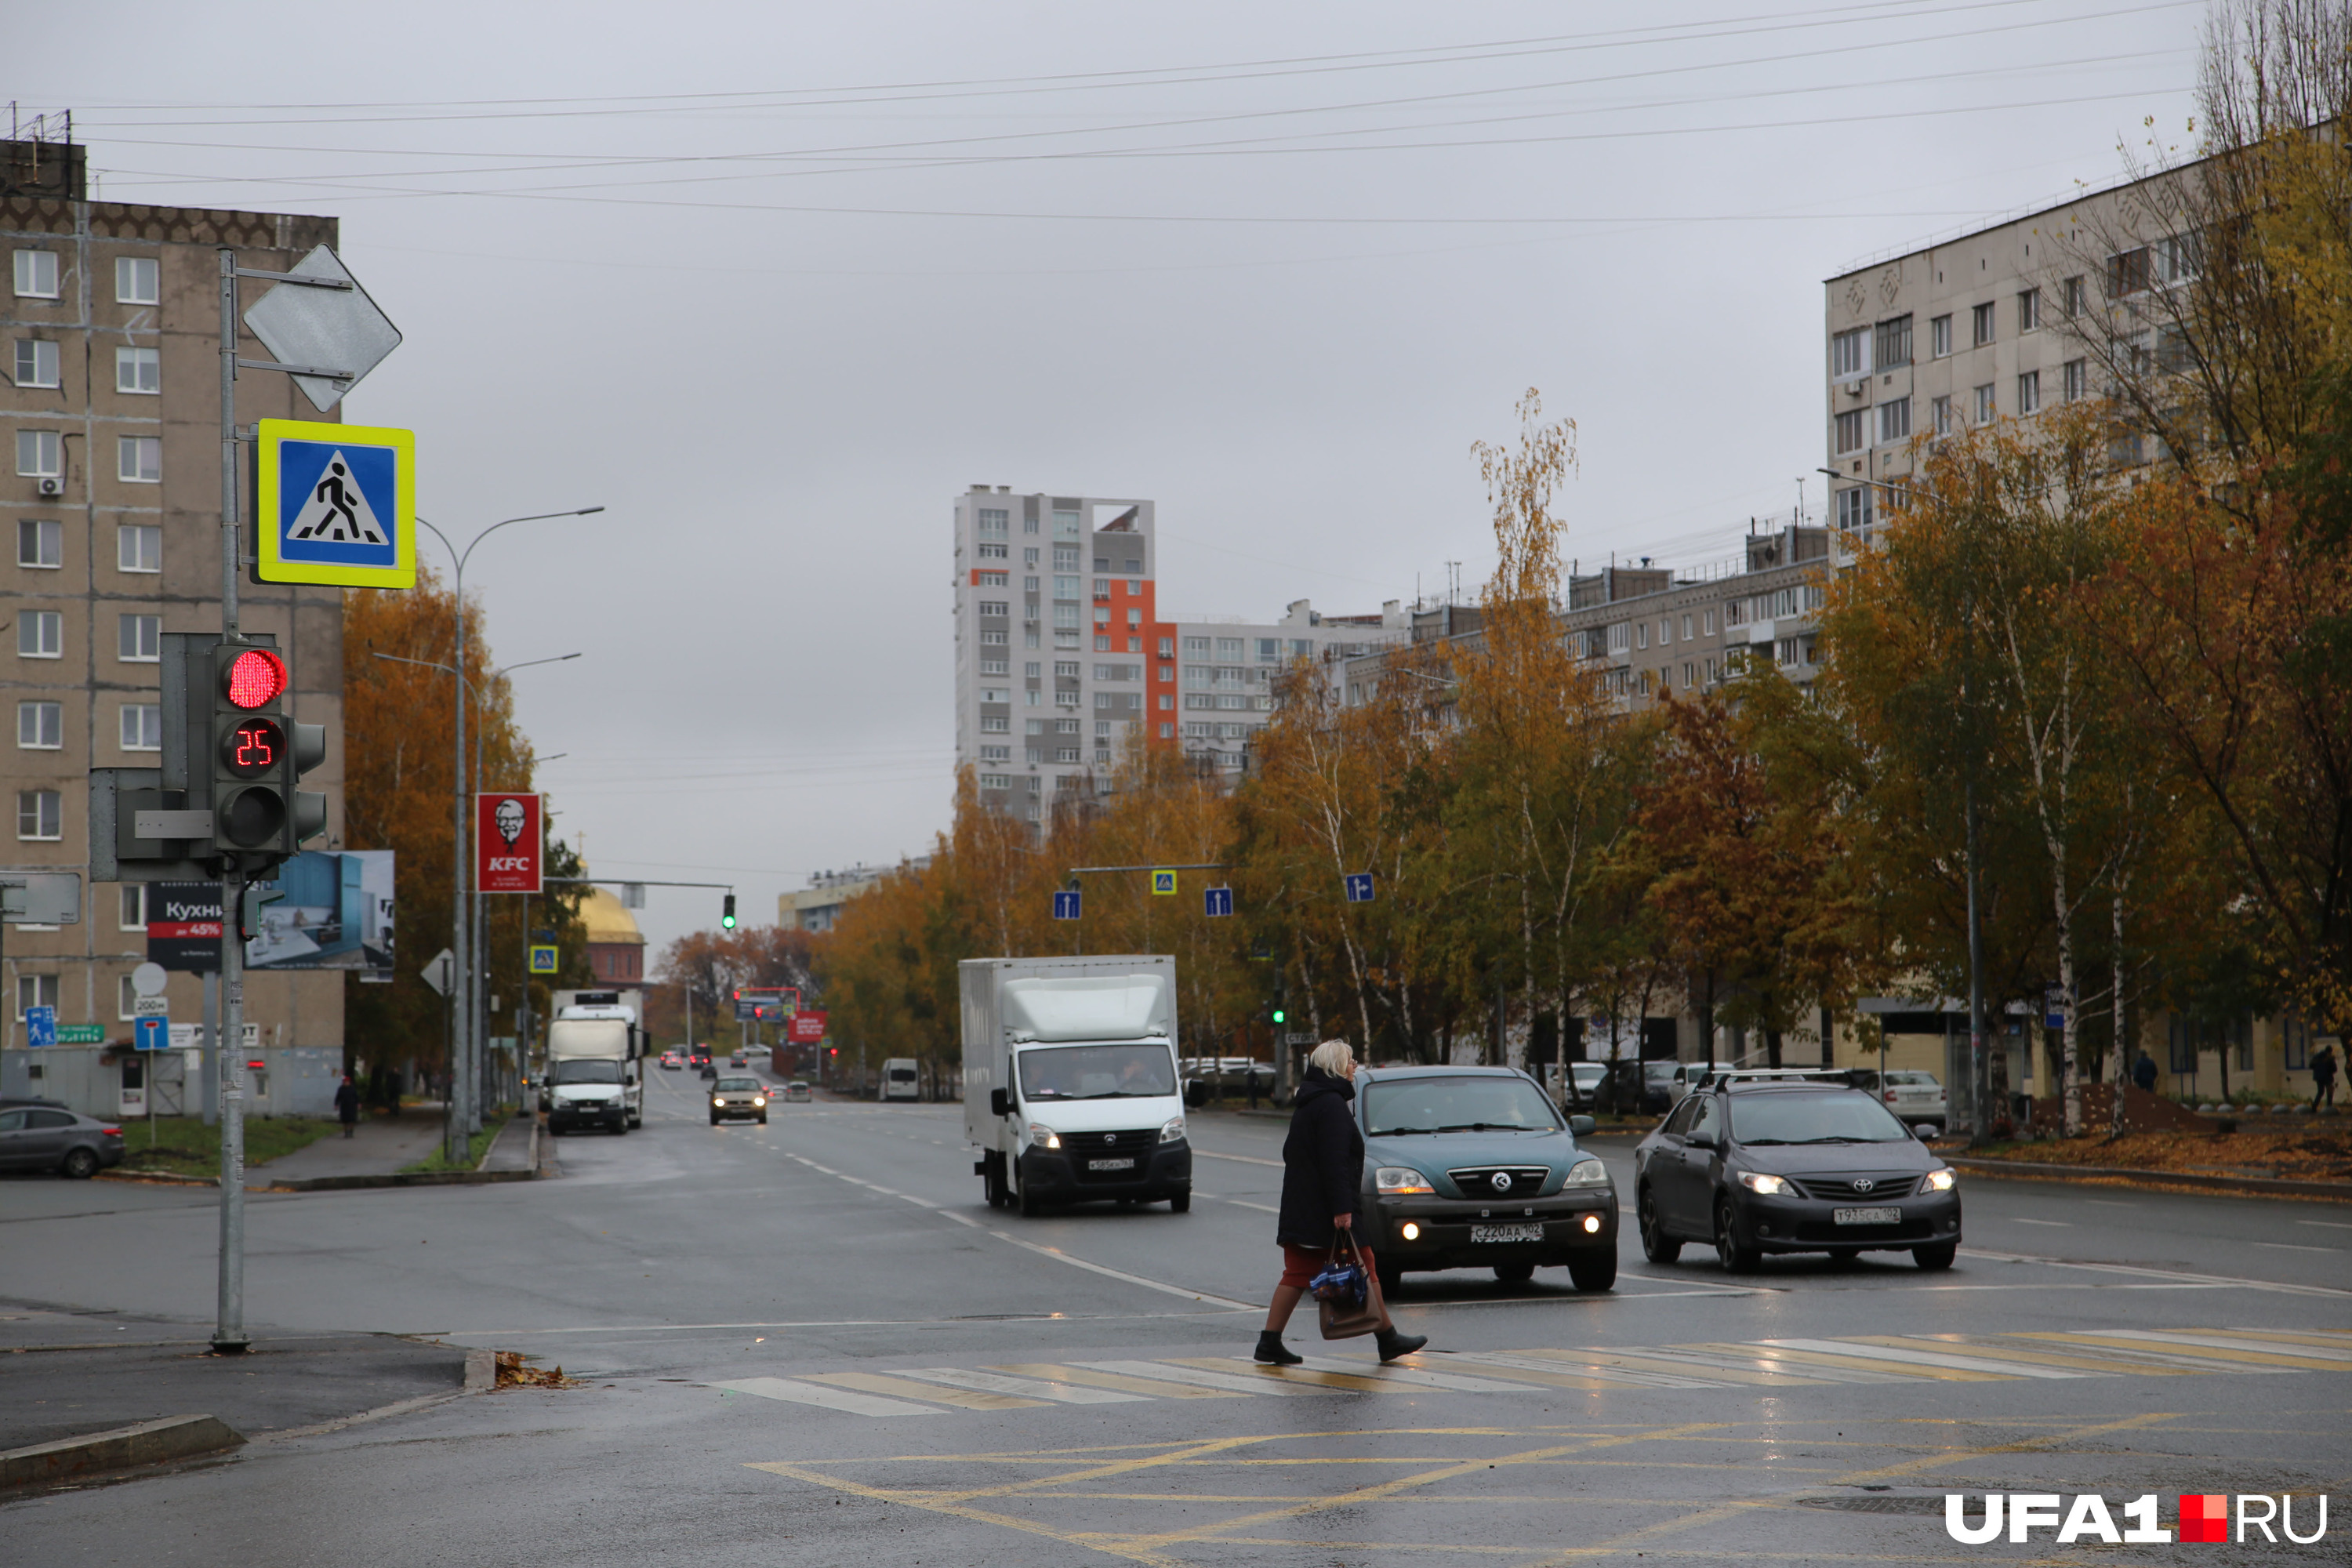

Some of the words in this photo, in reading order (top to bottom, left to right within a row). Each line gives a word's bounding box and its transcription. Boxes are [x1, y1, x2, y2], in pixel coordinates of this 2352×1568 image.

[237, 730, 271, 765] 25
[488, 856, 530, 872] KFC
[190, 924, 220, 935] 45%
